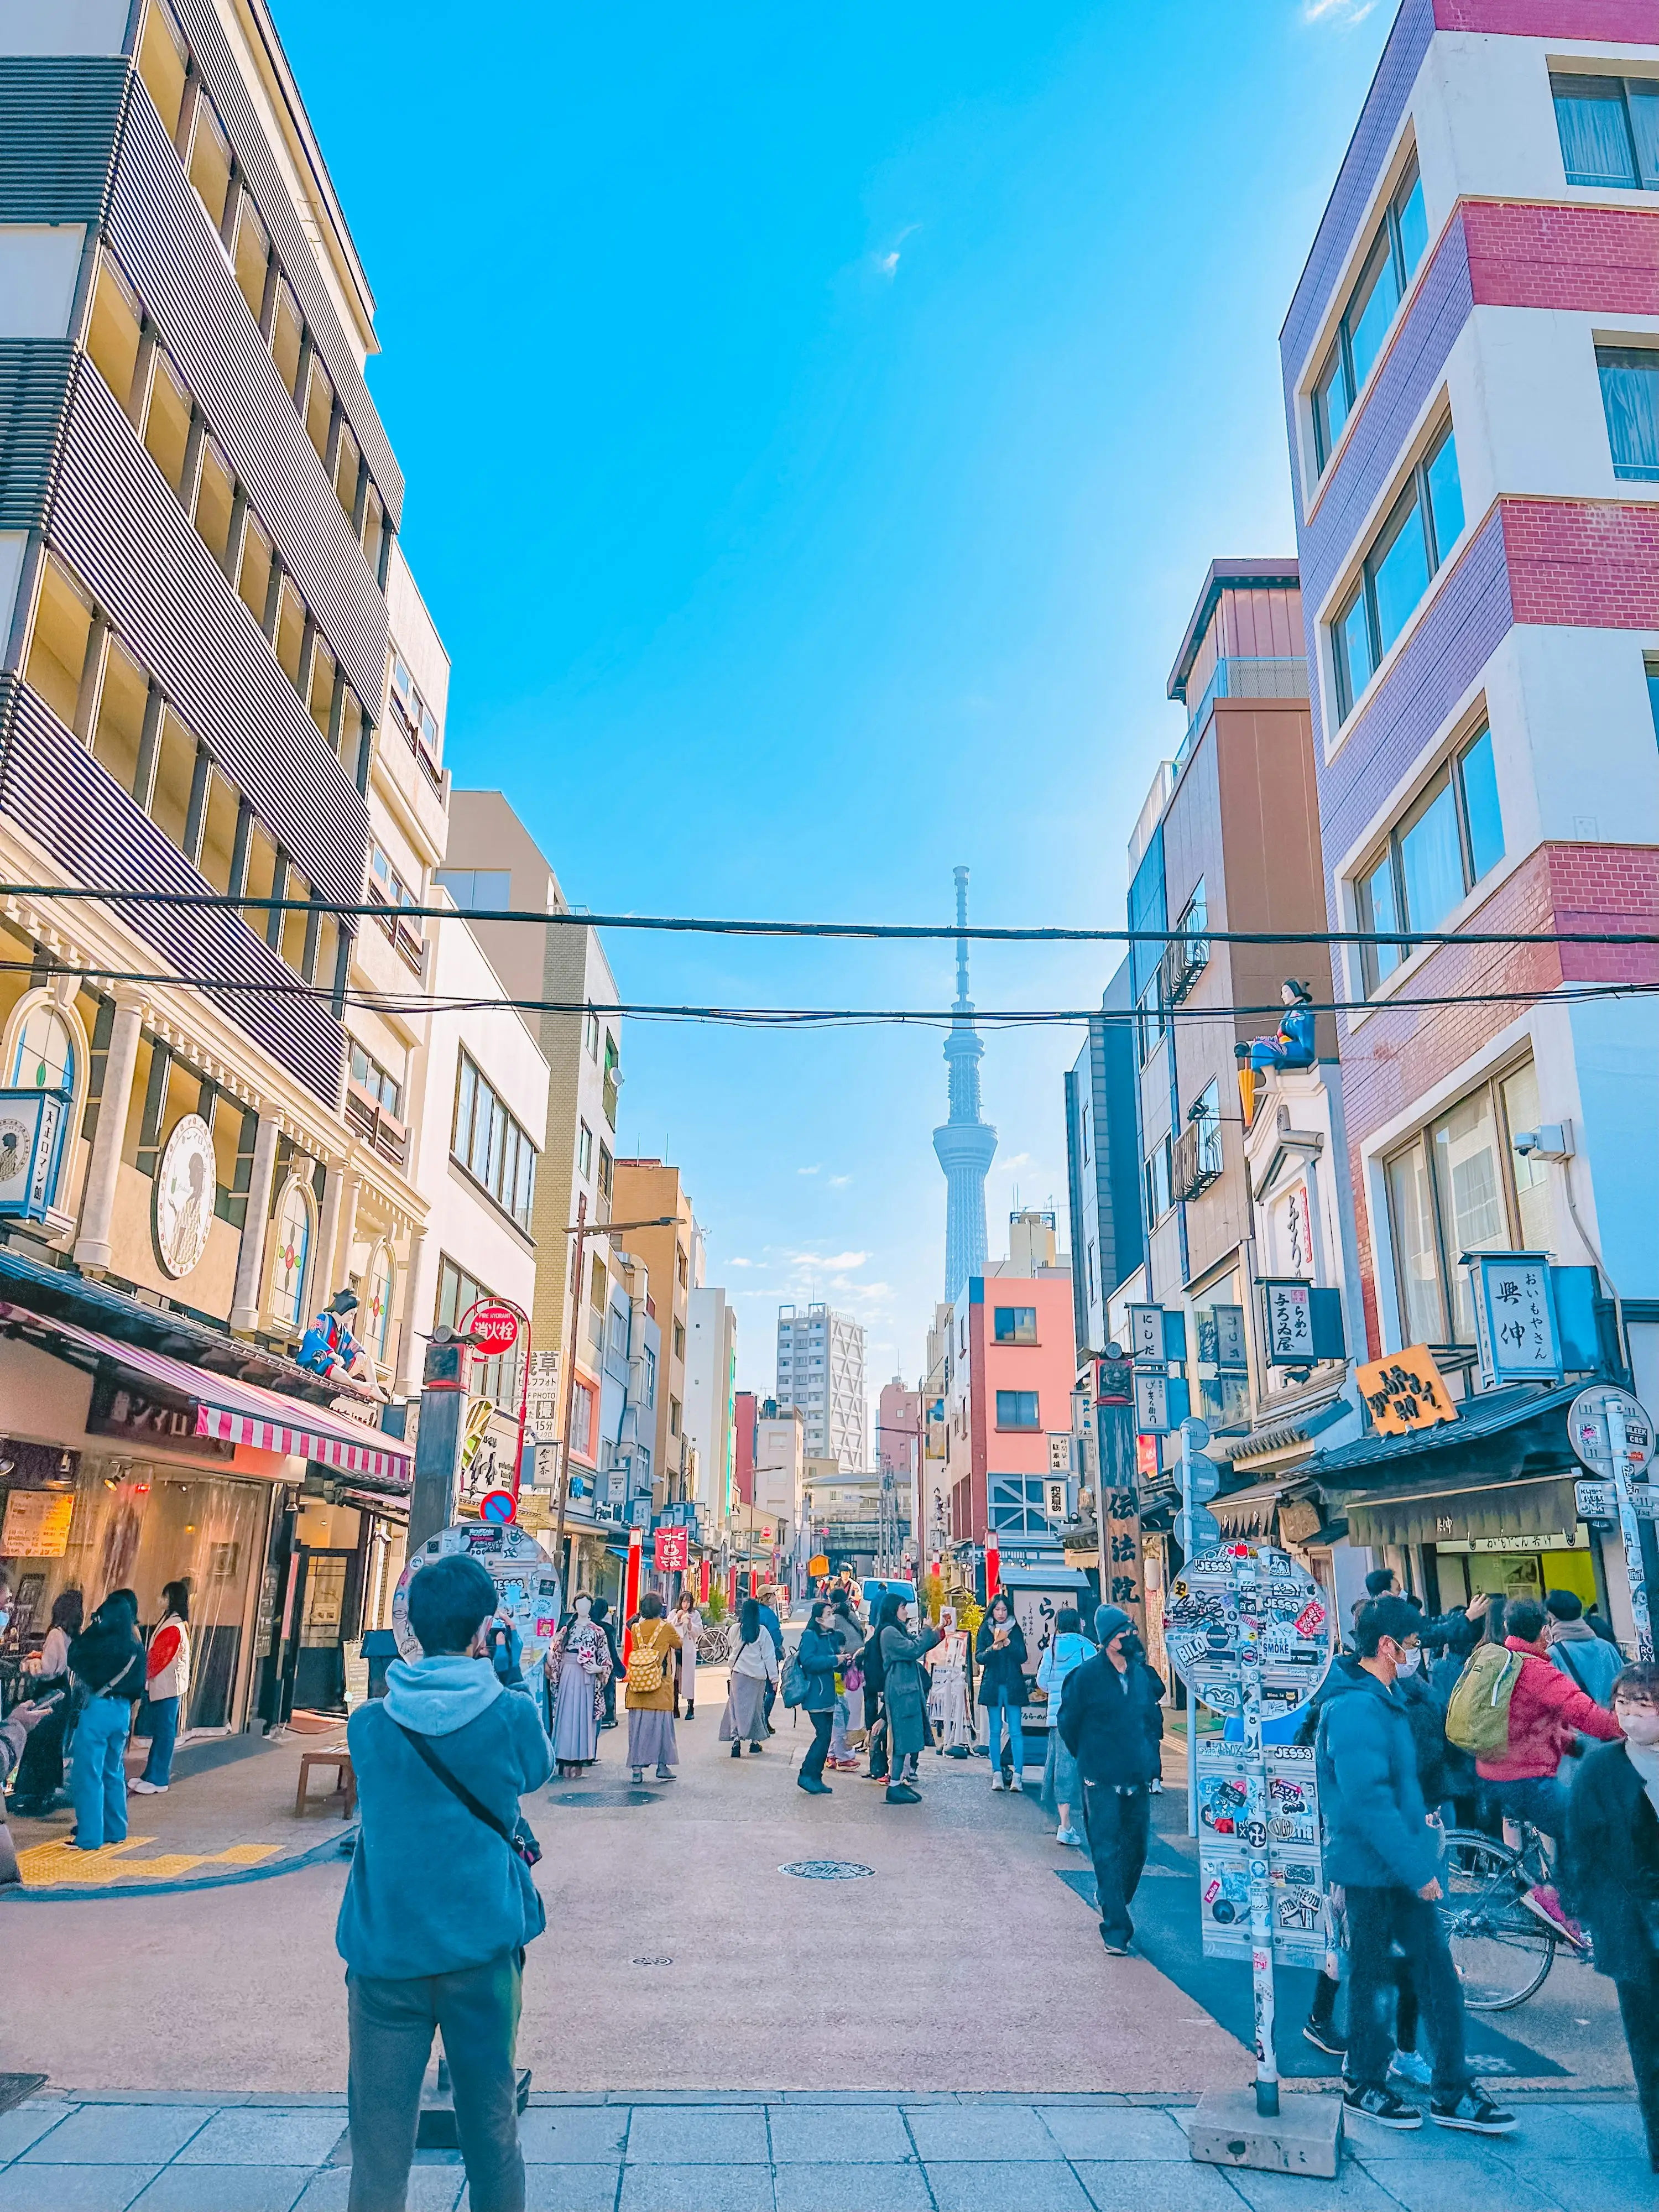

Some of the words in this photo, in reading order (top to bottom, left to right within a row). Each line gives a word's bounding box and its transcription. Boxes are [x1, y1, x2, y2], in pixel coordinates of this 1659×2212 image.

[1495, 1281, 1525, 1349] 興伸
[1525, 1273, 1547, 1359] おいもやさん
[474, 1321, 515, 1340] 消火栓
[1143, 1314, 1155, 1355] にしだ
[519, 1352, 559, 1376] 浅草
[535, 1421, 552, 1431] 15分
[1626, 1426, 1646, 1435] BLEEK
[1108, 1494, 1140, 1603] 伝法院
[1196, 1561, 1233, 1573] JESS3
[1263, 1597, 1300, 1614] JESS3
[1177, 1637, 1206, 1663] BILO
[1263, 1643, 1290, 1654] SMOKE
[1275, 1746, 1313, 1761] JESS3
